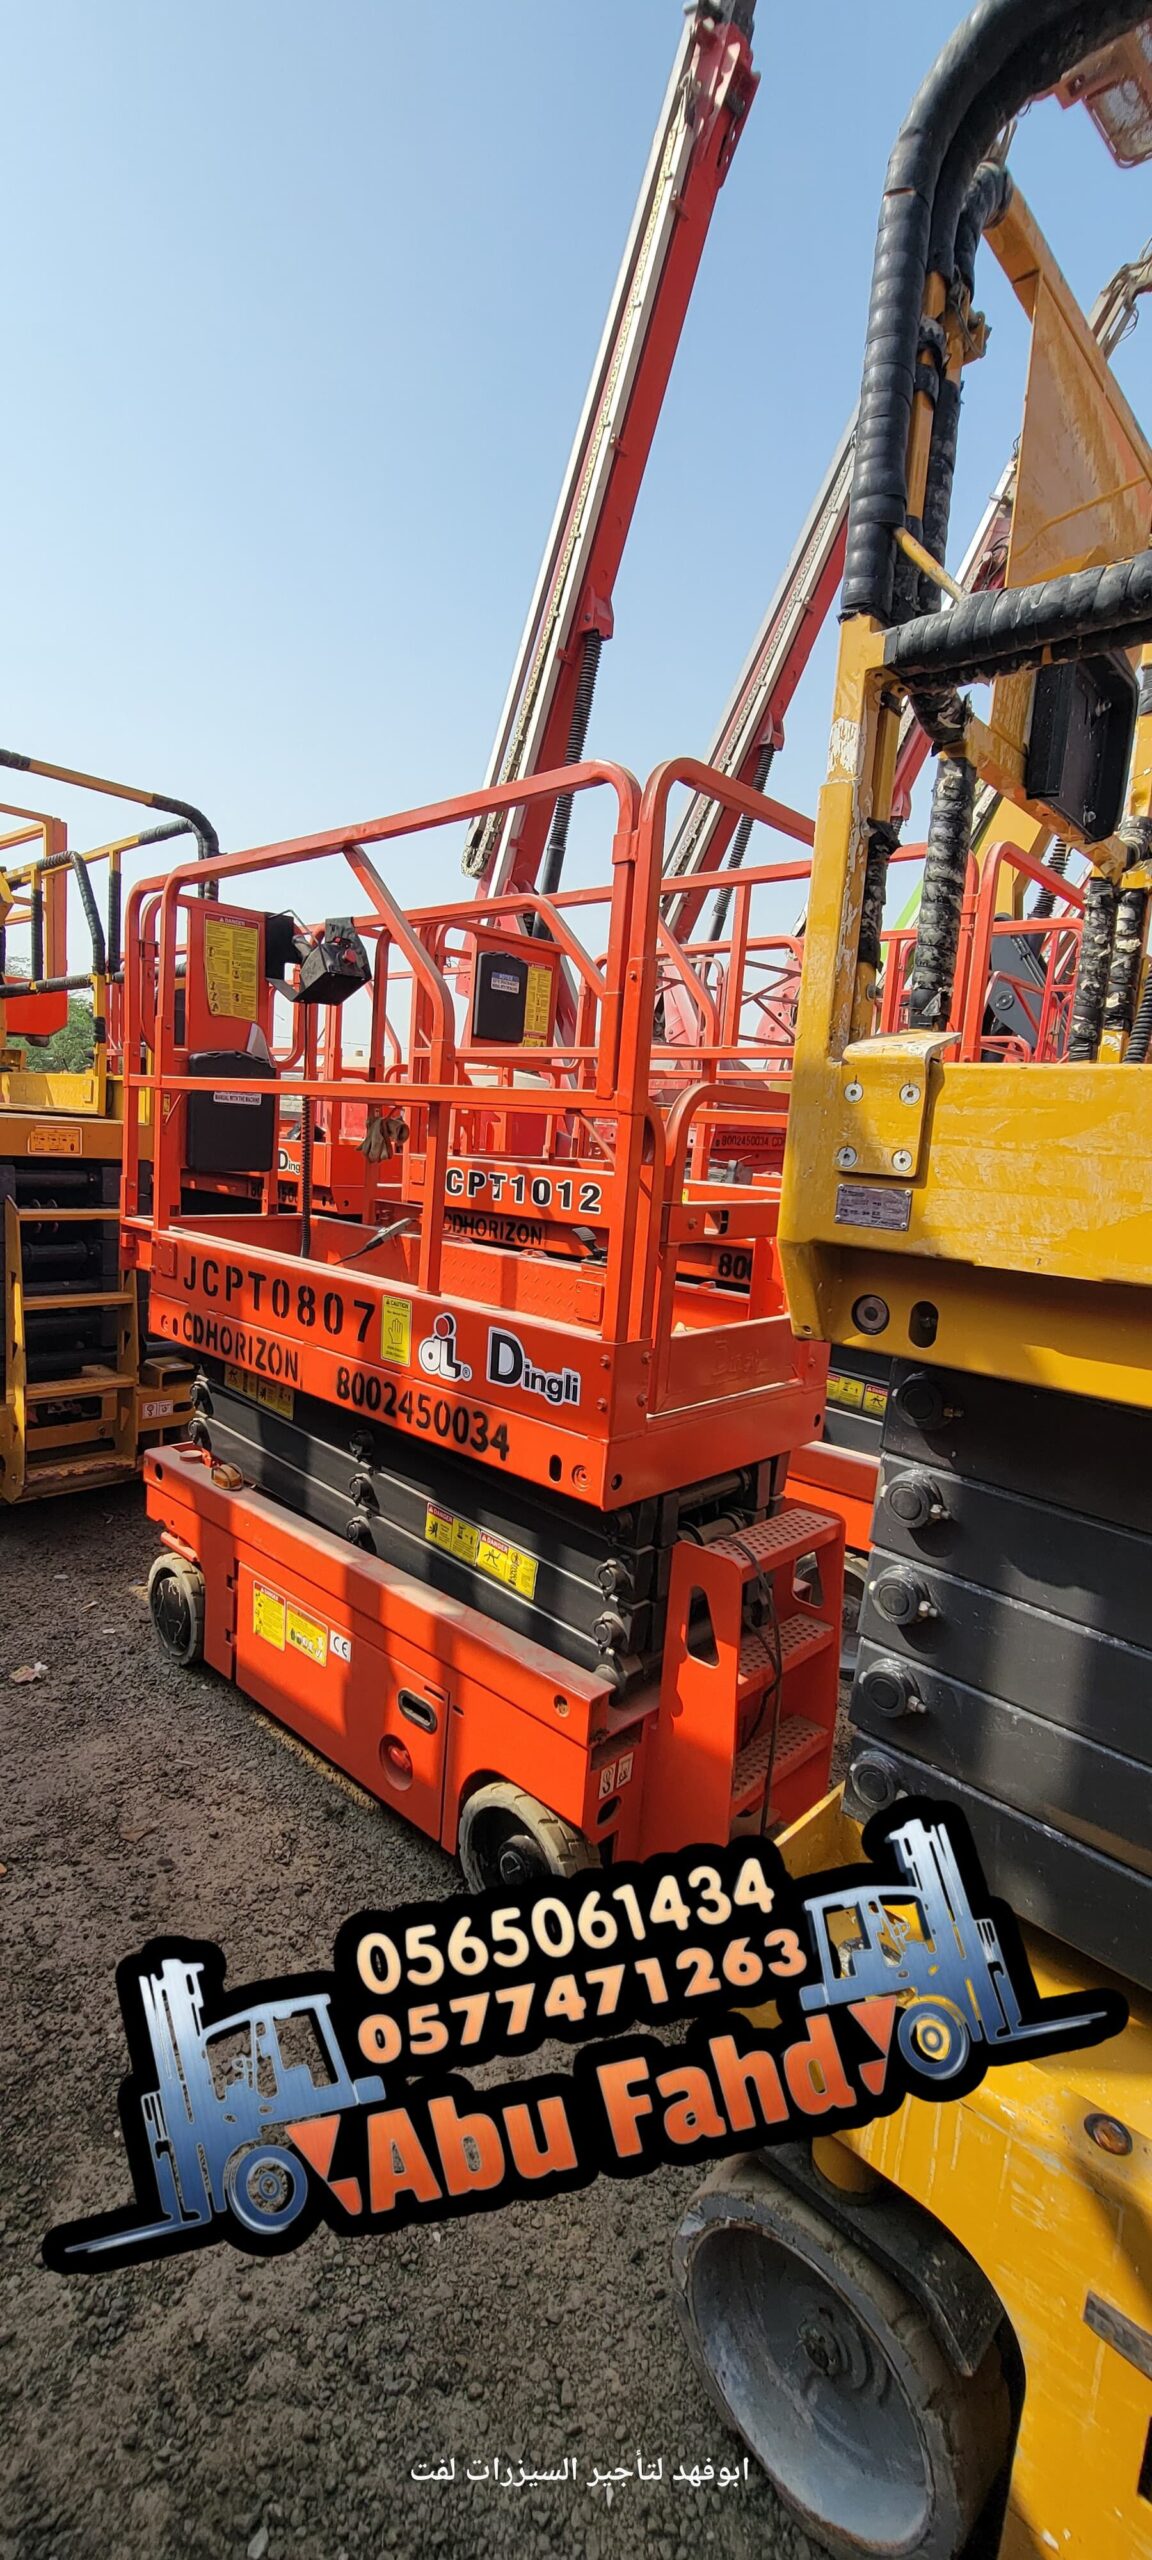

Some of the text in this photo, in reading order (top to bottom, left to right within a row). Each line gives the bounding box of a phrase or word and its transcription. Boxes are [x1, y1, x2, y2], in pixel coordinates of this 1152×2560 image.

[184, 1256, 375, 1343] JCPT0807
[391, 1300, 409, 1309] CAUTION
[183, 1311, 299, 1382] CDHORIZON
[336, 1366, 509, 1461] 8002450034
[488, 1330, 580, 1403] Dingli
[433, 1508, 453, 1523] DANGER
[487, 1538, 509, 1553] DANGER
